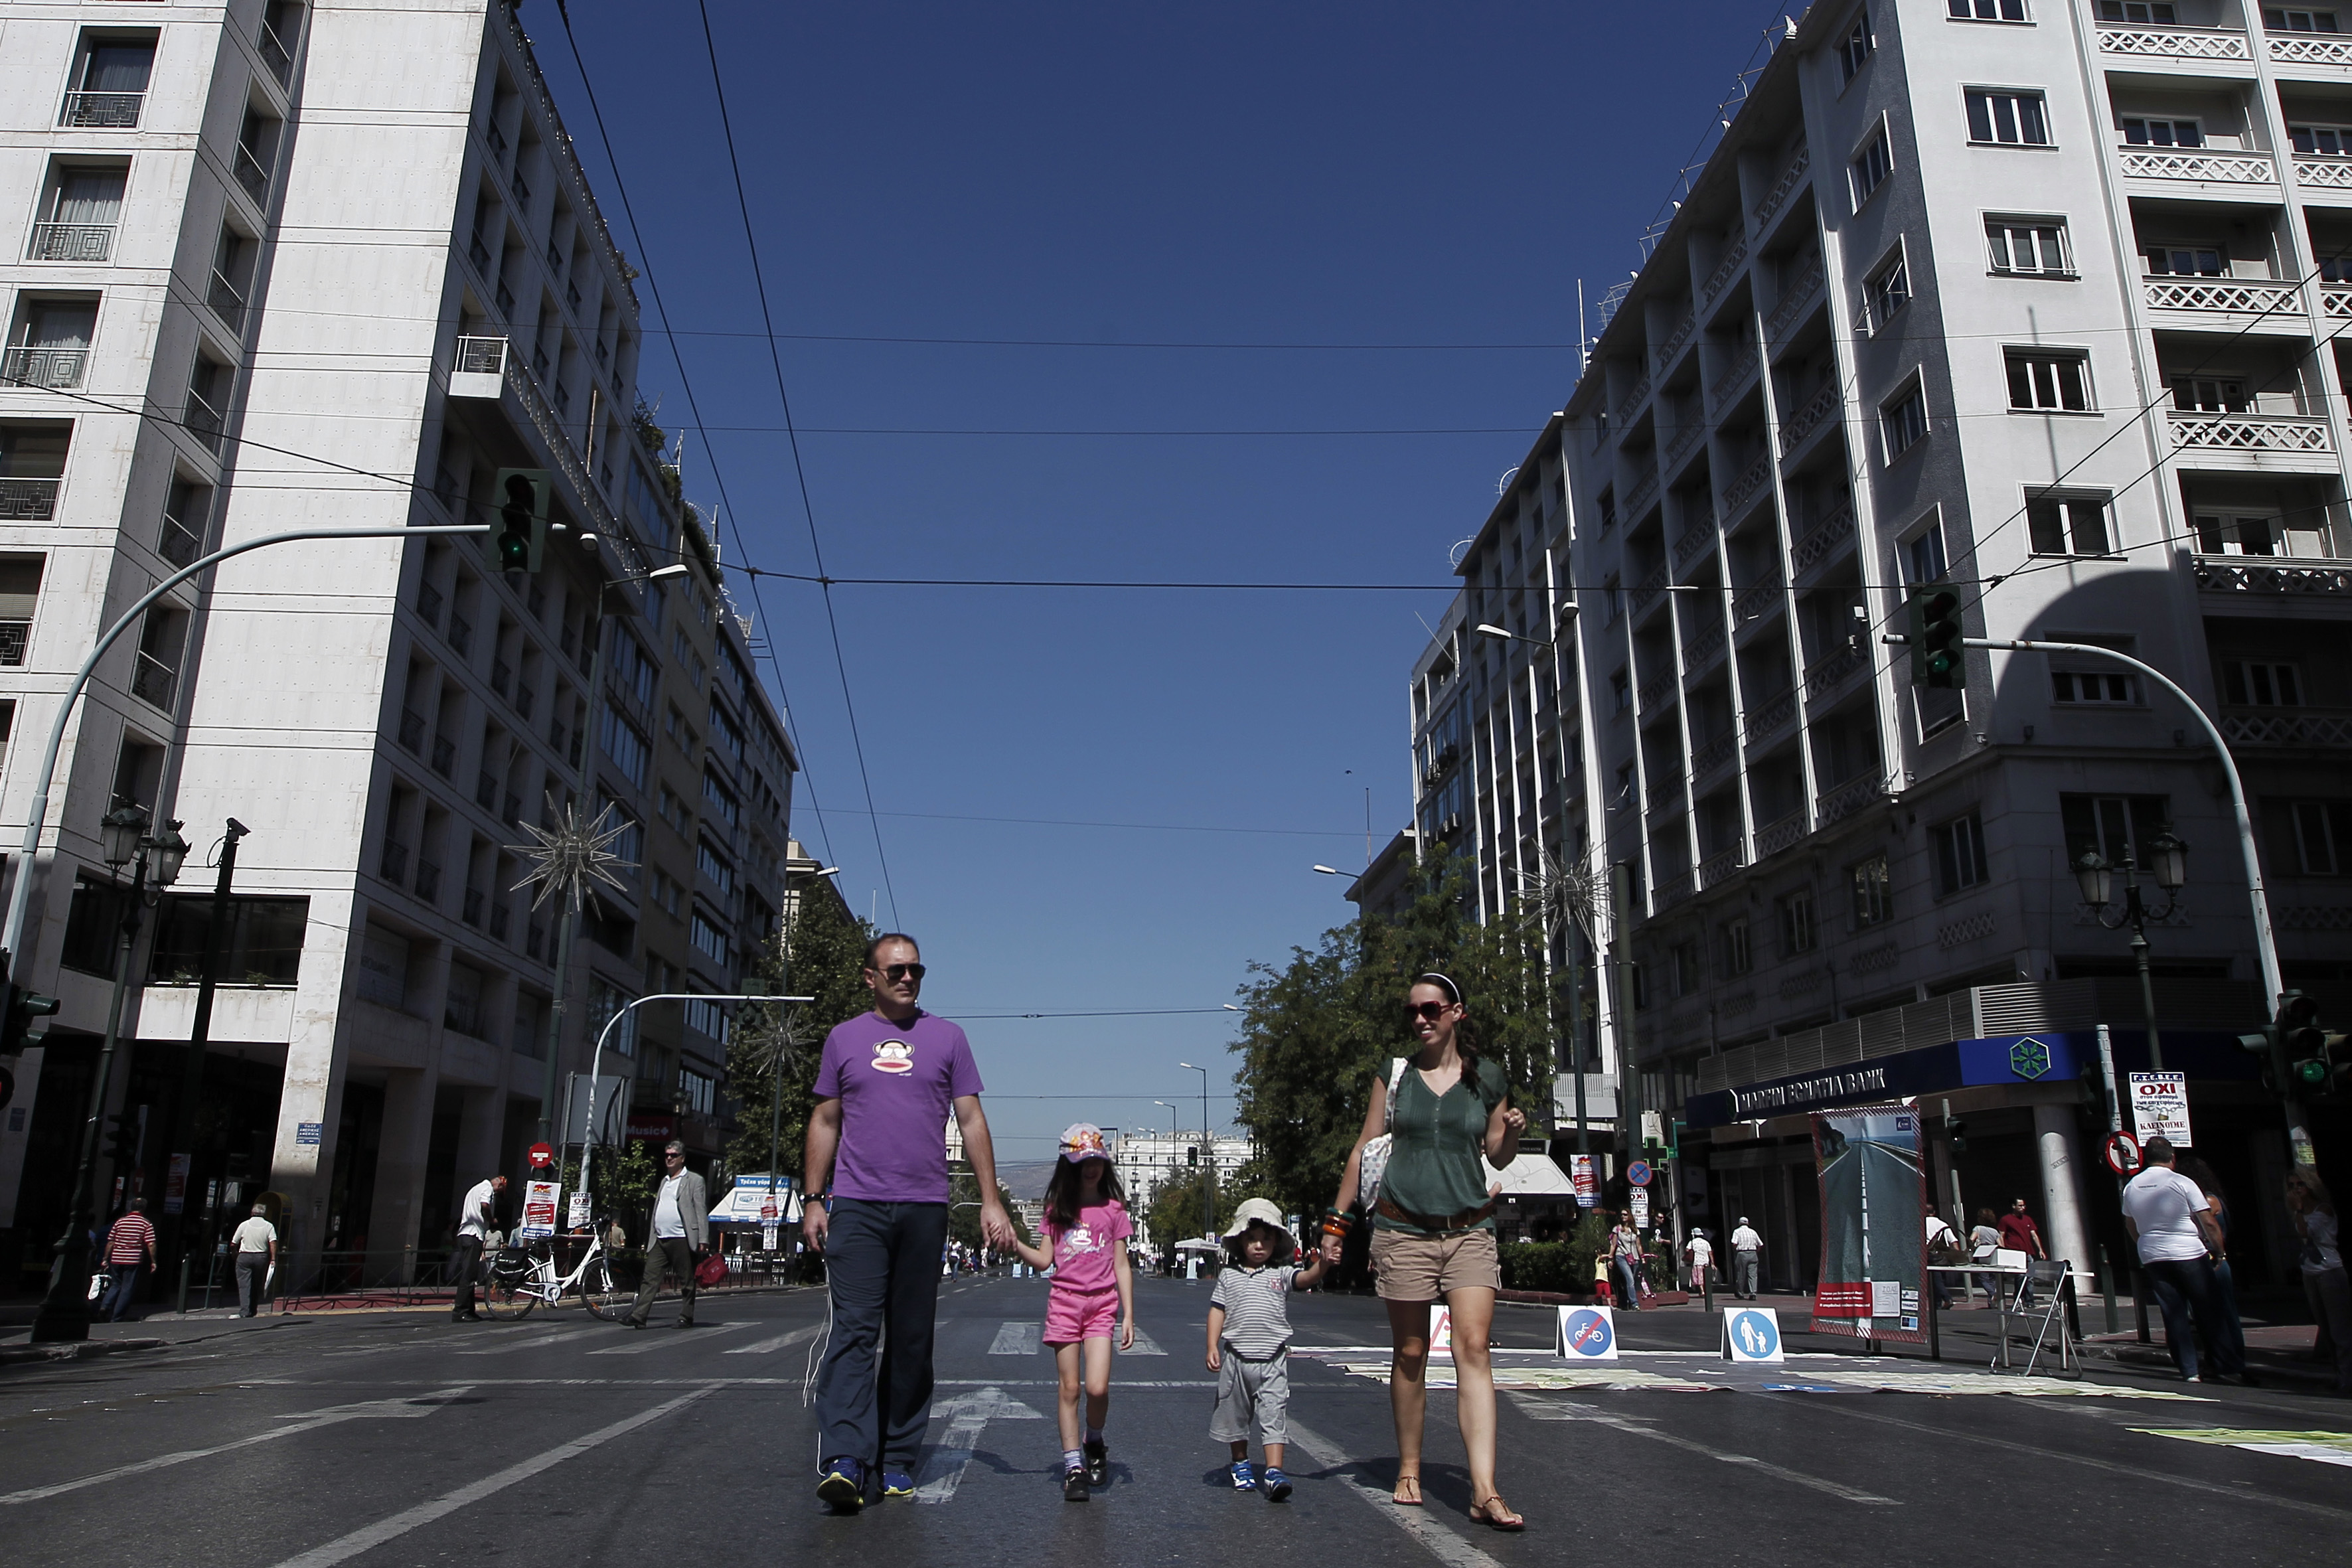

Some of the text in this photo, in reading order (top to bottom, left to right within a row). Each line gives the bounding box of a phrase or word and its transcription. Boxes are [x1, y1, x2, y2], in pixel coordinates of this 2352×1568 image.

[1740, 1067, 1885, 1112] MARFIN EGNATIA BANK
[2140, 1083, 2176, 1095] ΟΧΙ
[2140, 1121, 2185, 1130] ΚΛΕΙΝΟΥΜΕ
